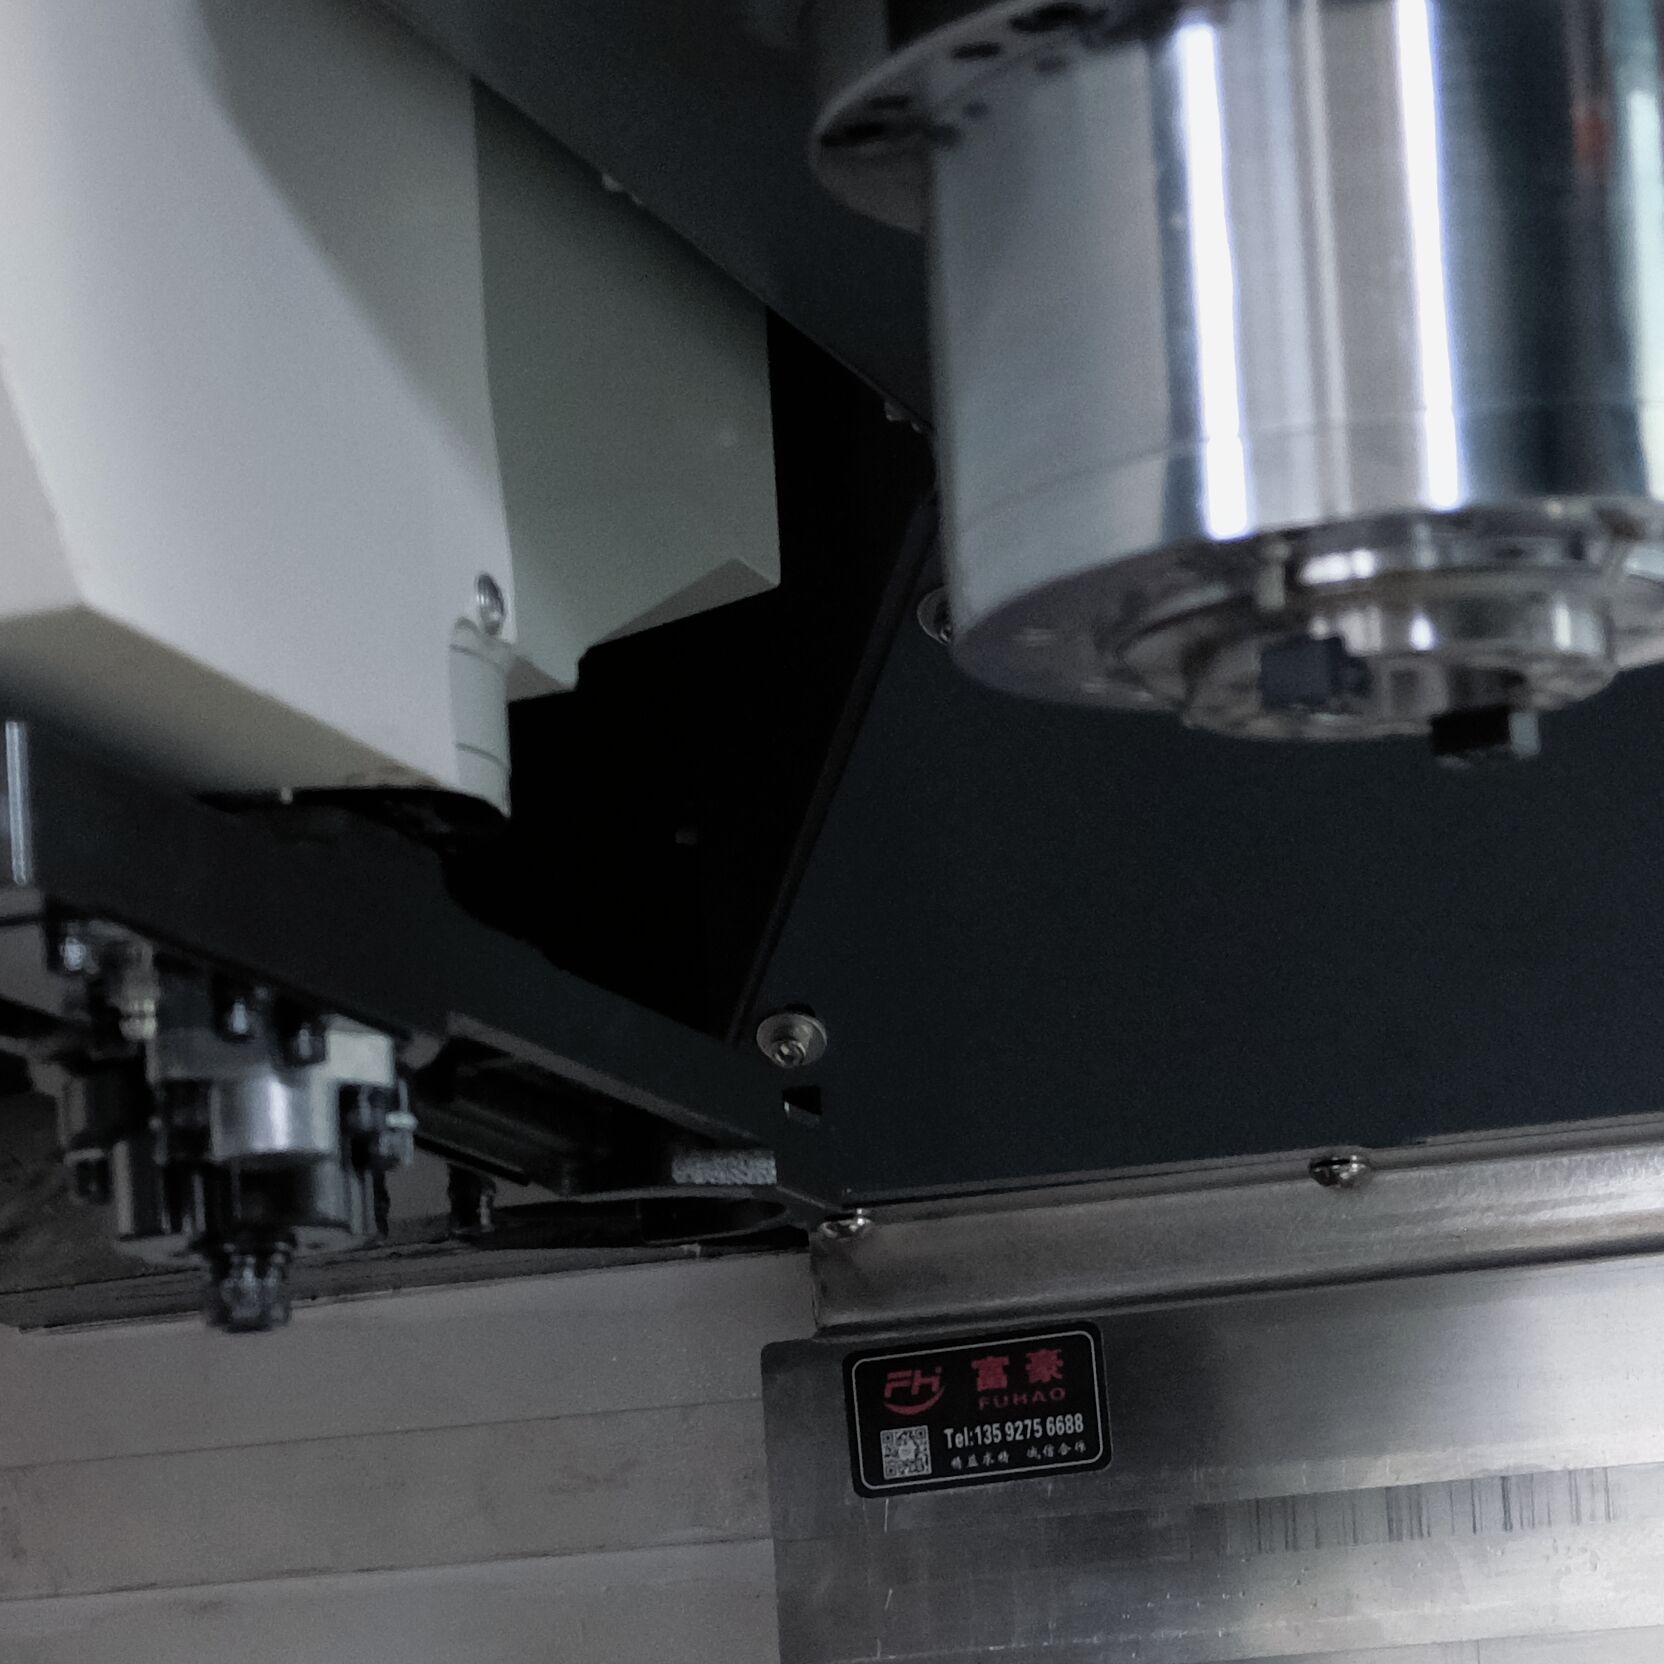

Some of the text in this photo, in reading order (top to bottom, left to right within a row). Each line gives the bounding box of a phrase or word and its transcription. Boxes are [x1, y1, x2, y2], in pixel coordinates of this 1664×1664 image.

[971, 1349, 1065, 1391] 富豪
[978, 1386, 1067, 1411] FUHAO
[943, 1412, 1085, 1449] Tel:135 9275 6688
